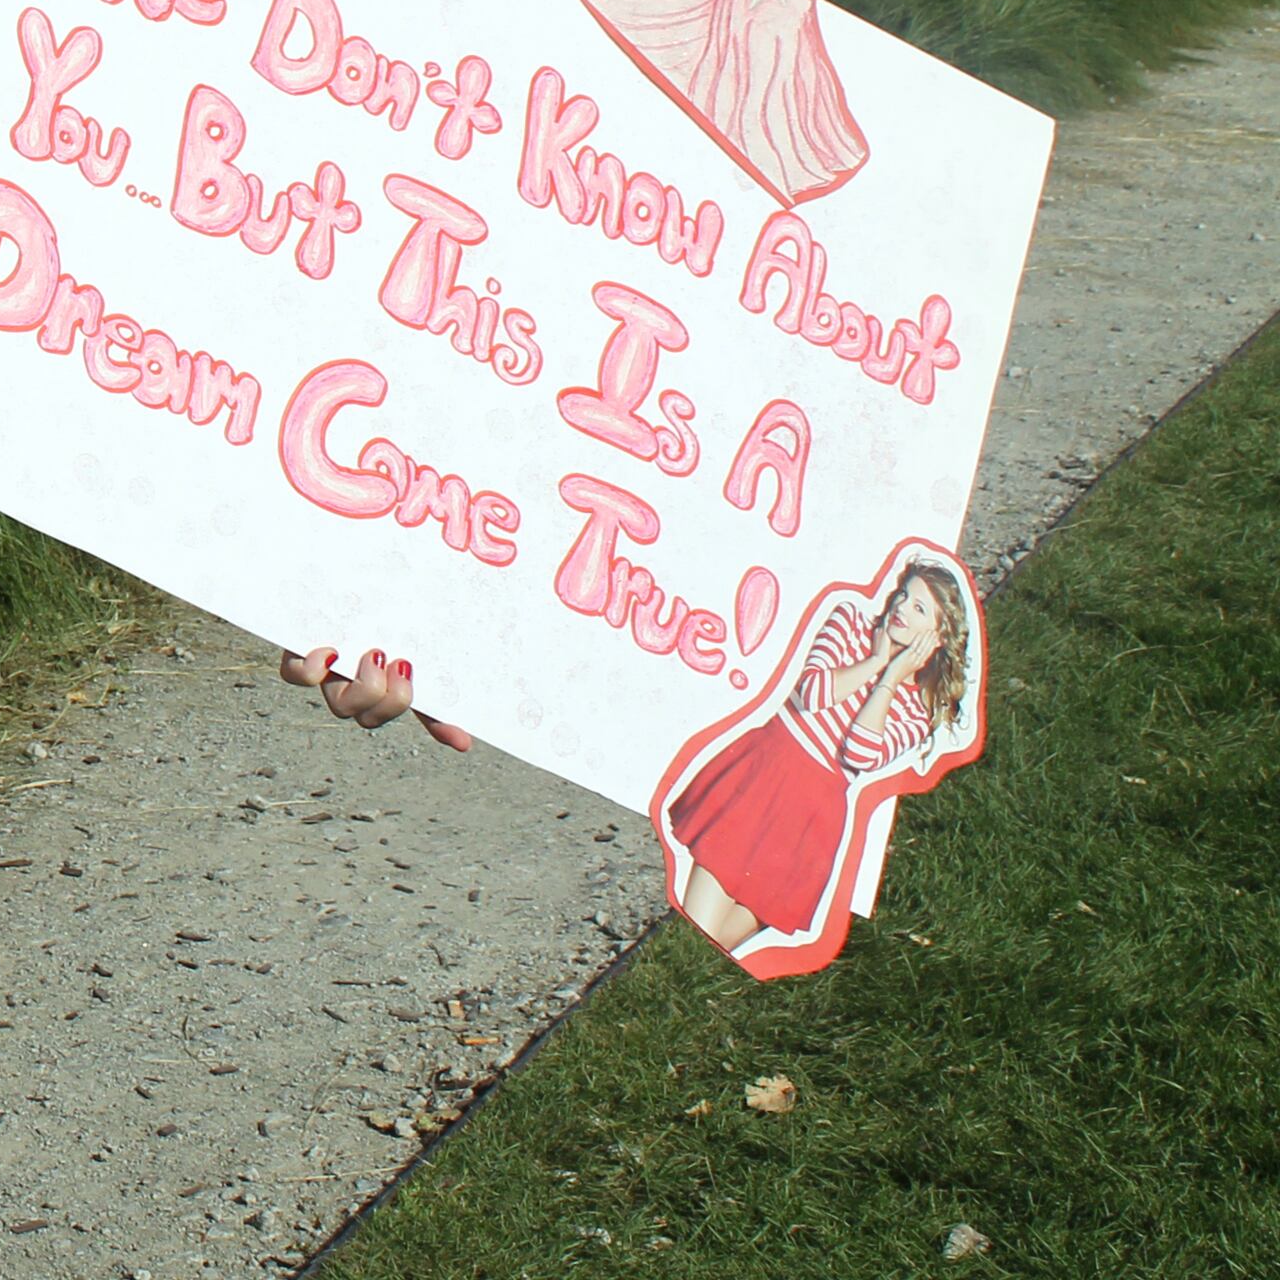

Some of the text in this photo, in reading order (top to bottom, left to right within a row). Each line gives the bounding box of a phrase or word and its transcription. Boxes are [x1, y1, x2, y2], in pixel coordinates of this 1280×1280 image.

[170, 84, 362, 280] But
[378, 173, 543, 386] This
[556, 280, 700, 477] Is
[723, 397, 812, 538] A
[517, 66, 725, 278] Know
[739, 209, 961, 406] About
[278, 358, 522, 568] Come
[553, 471, 781, 690] True!
